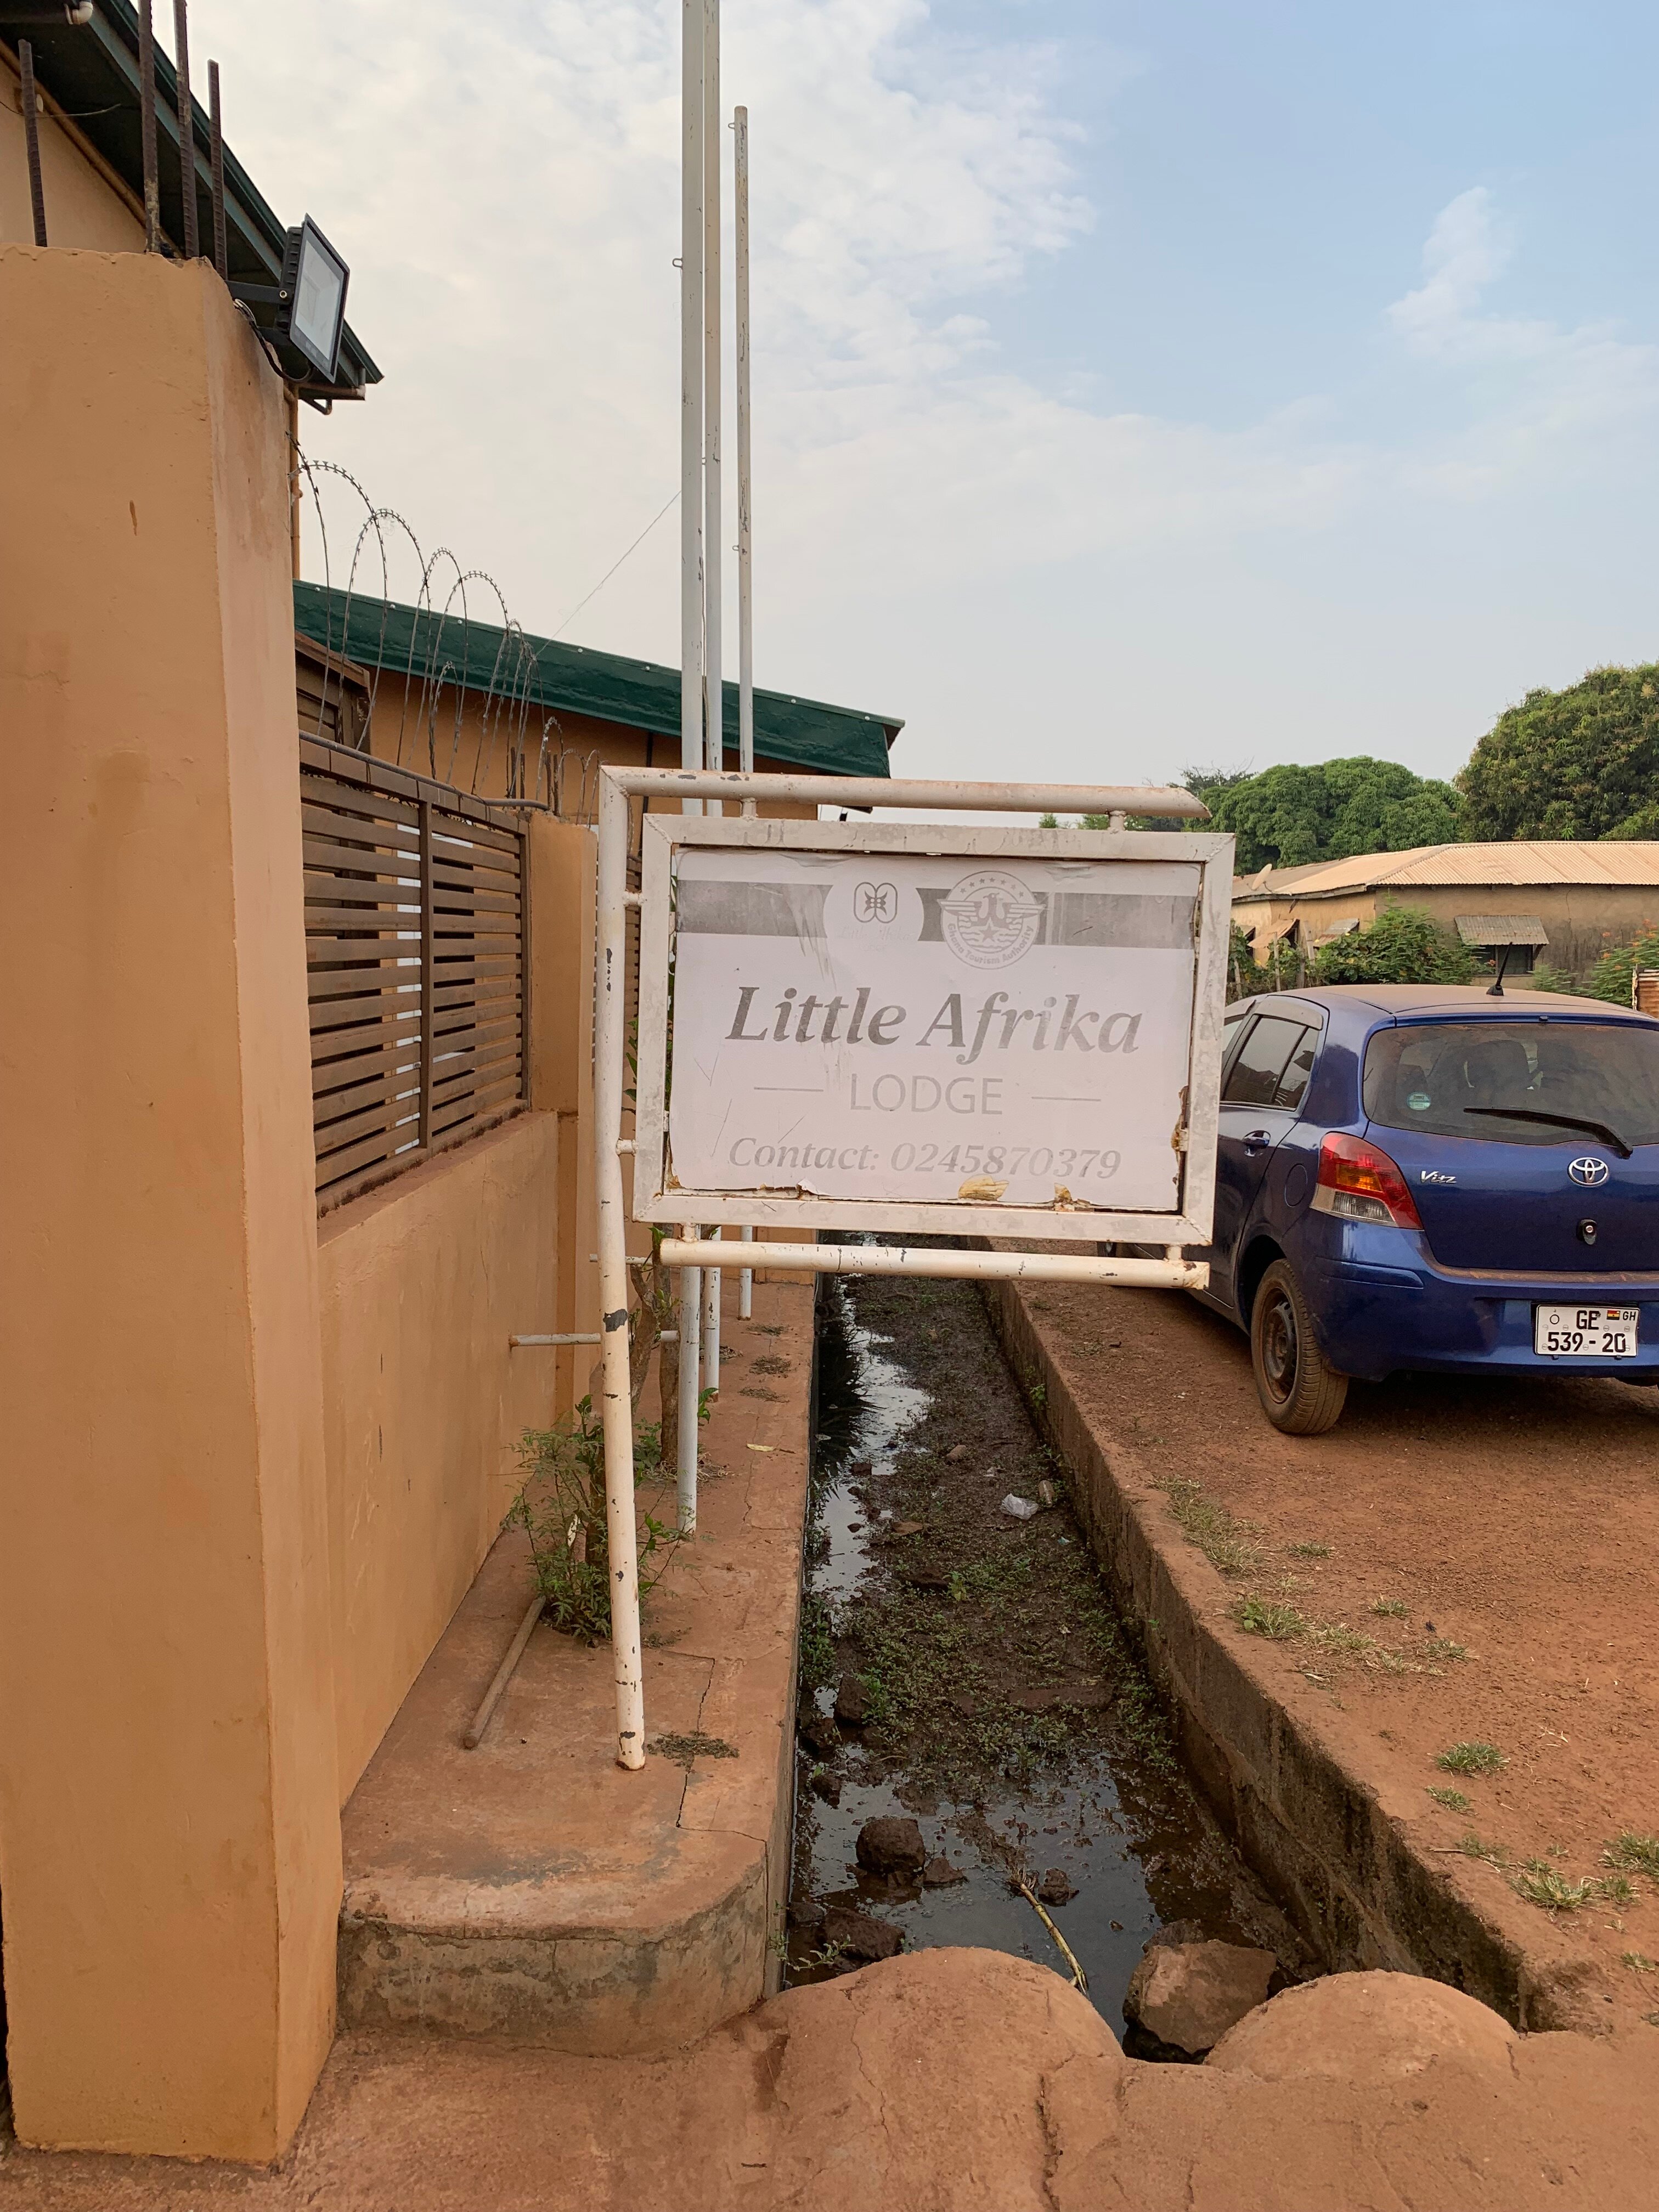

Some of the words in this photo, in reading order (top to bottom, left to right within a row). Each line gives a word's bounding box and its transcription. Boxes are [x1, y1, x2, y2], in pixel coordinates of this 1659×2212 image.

[947, 923, 964, 953] Ghana
[964, 950, 1000, 965] Tourism
[1002, 926, 1034, 962] Authority
[725, 986, 907, 1045] Little
[917, 990, 1142, 1065] Afrika
[850, 1073, 1003, 1116] LODGE
[728, 1136, 879, 1172] Contact:
[891, 1142, 1121, 1179] 0245870379
[1420, 1170, 1457, 1183] Vitz
[1576, 1310, 1599, 1330] GE
[1623, 1311, 1637, 1321] GH
